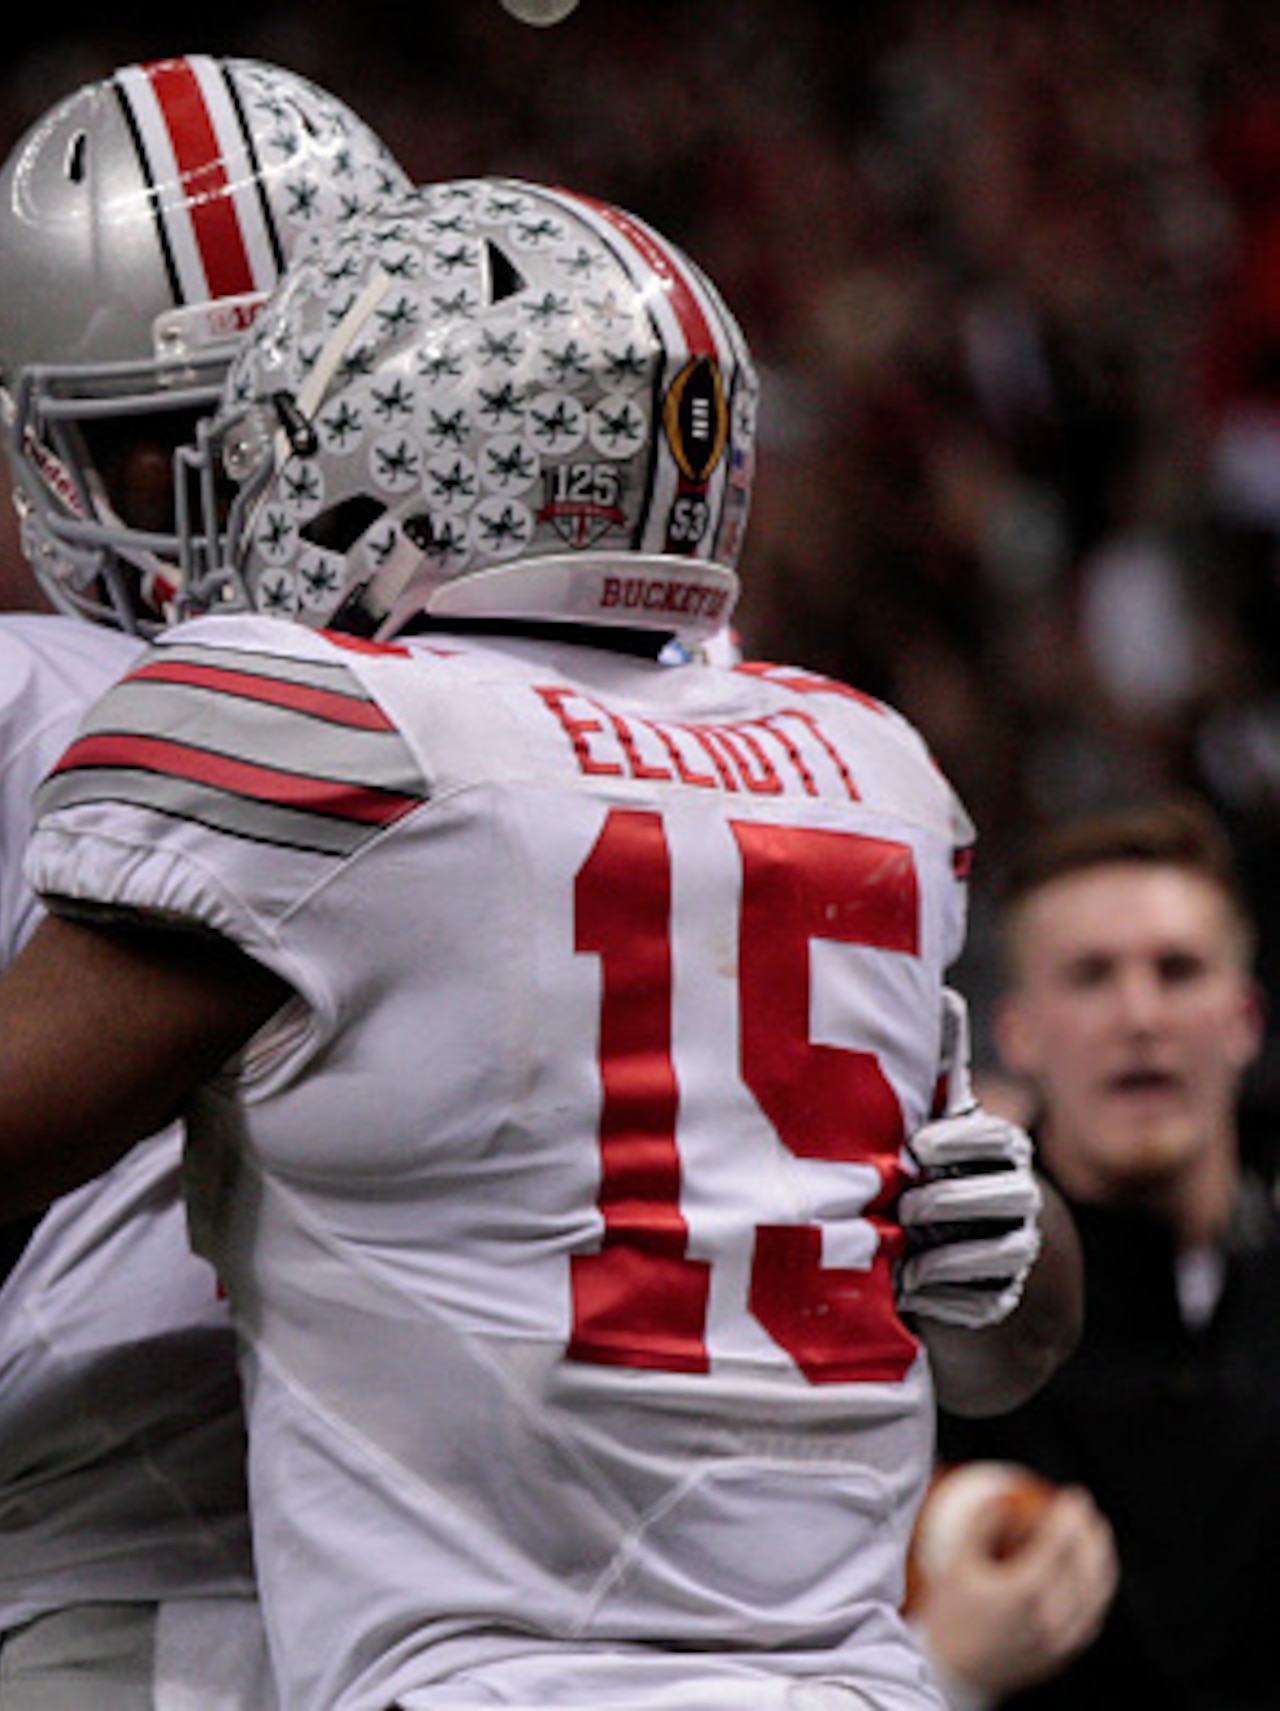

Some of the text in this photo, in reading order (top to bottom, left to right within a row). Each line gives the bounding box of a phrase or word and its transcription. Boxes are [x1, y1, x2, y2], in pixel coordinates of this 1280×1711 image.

[555, 464, 618, 505] 125
[670, 498, 708, 541] 53
[534, 686, 861, 803] ELLIOTT
[566, 808, 920, 1386] 15
